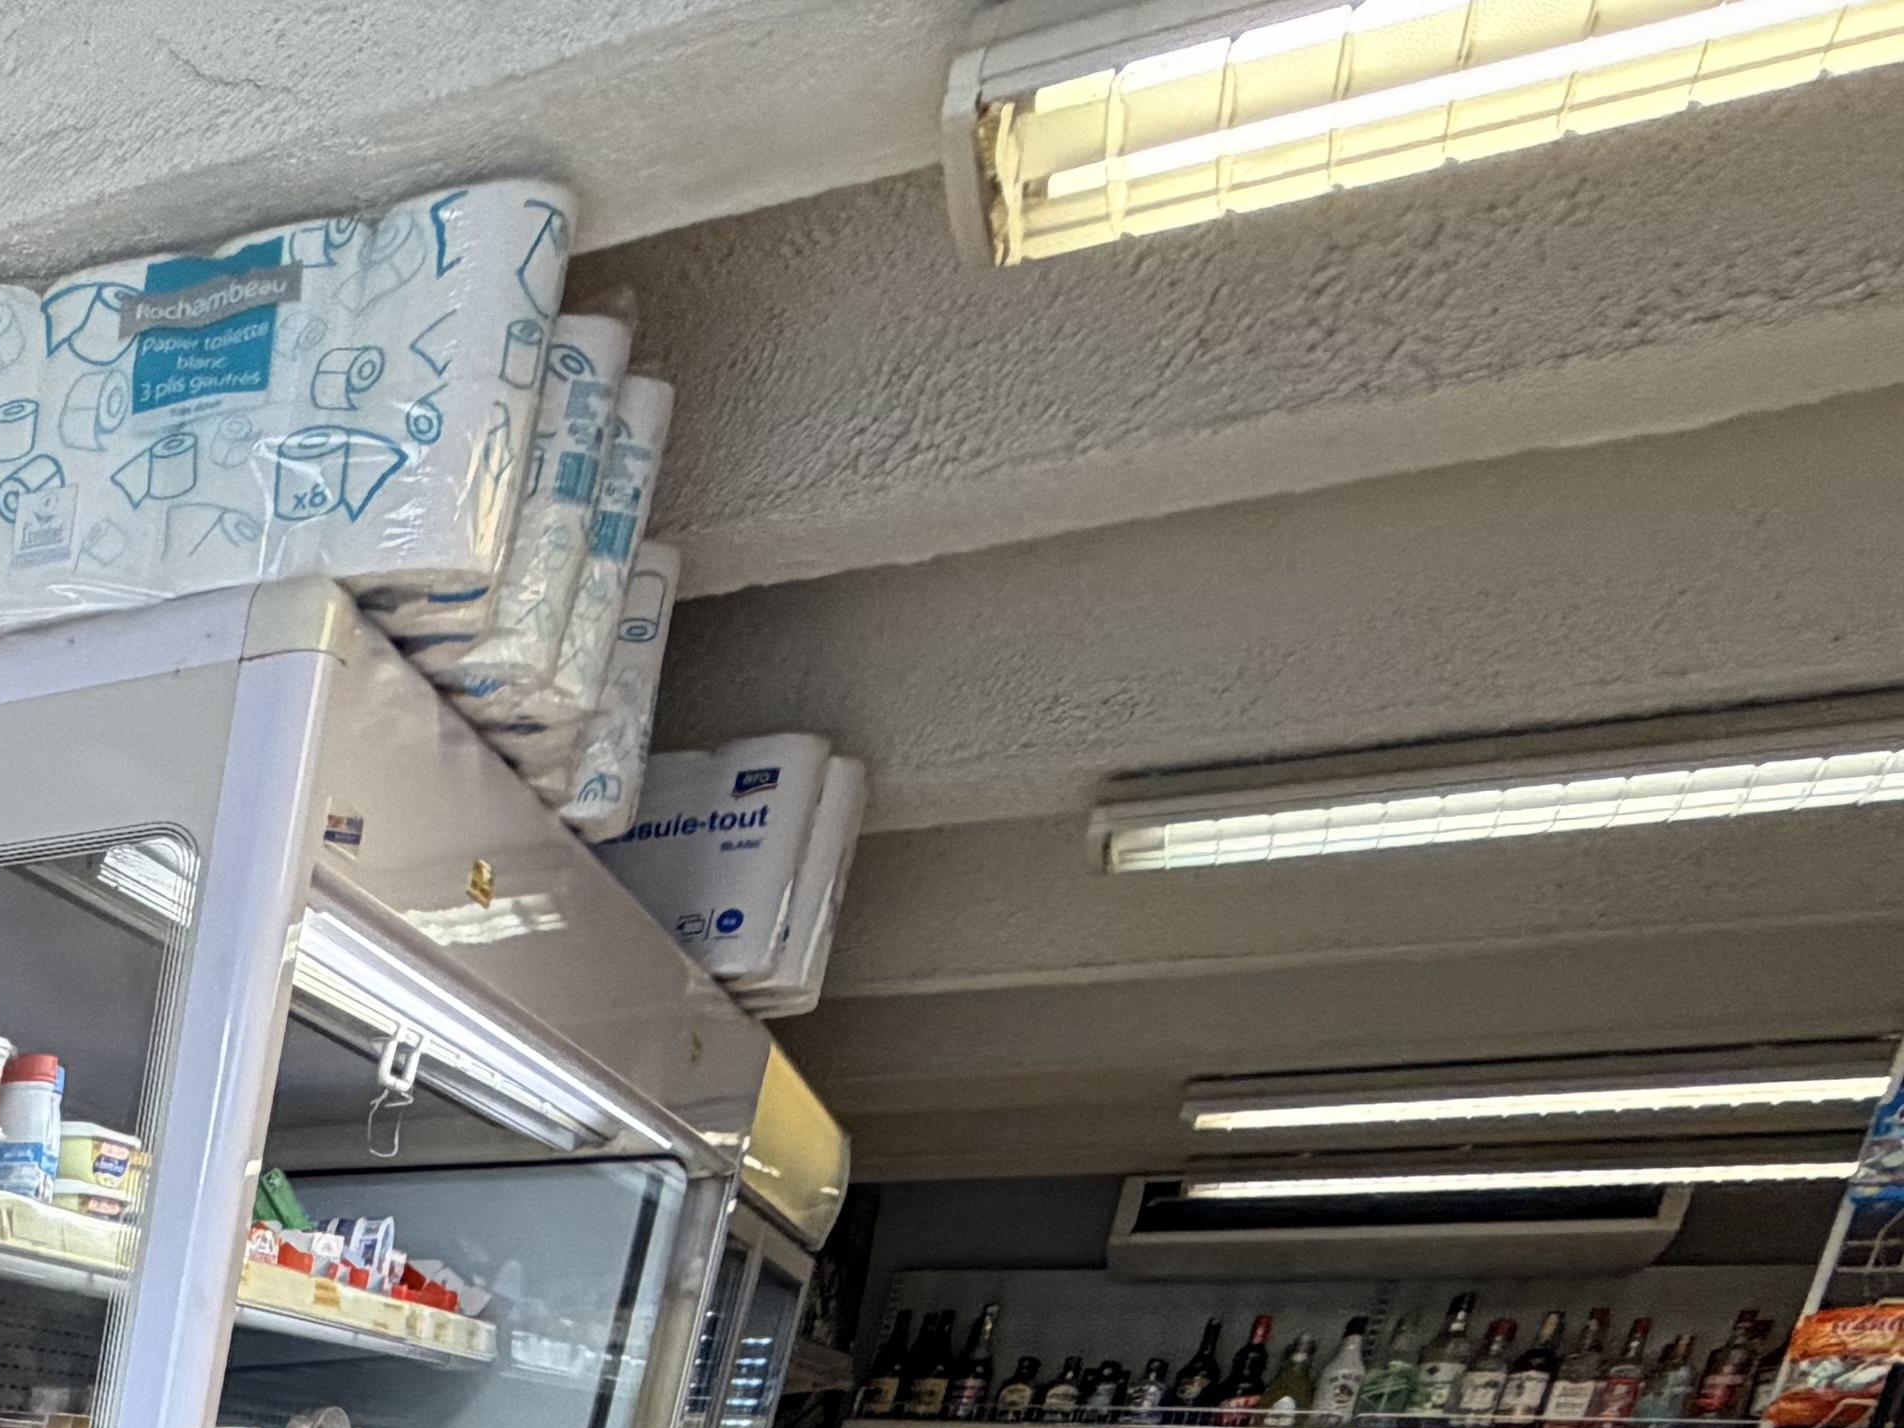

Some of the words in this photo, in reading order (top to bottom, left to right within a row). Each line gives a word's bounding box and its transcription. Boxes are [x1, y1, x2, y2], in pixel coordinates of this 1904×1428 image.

[136, 277, 288, 320] Rochambeau
[140, 384, 150, 402] 3
[155, 377, 185, 403] plis
